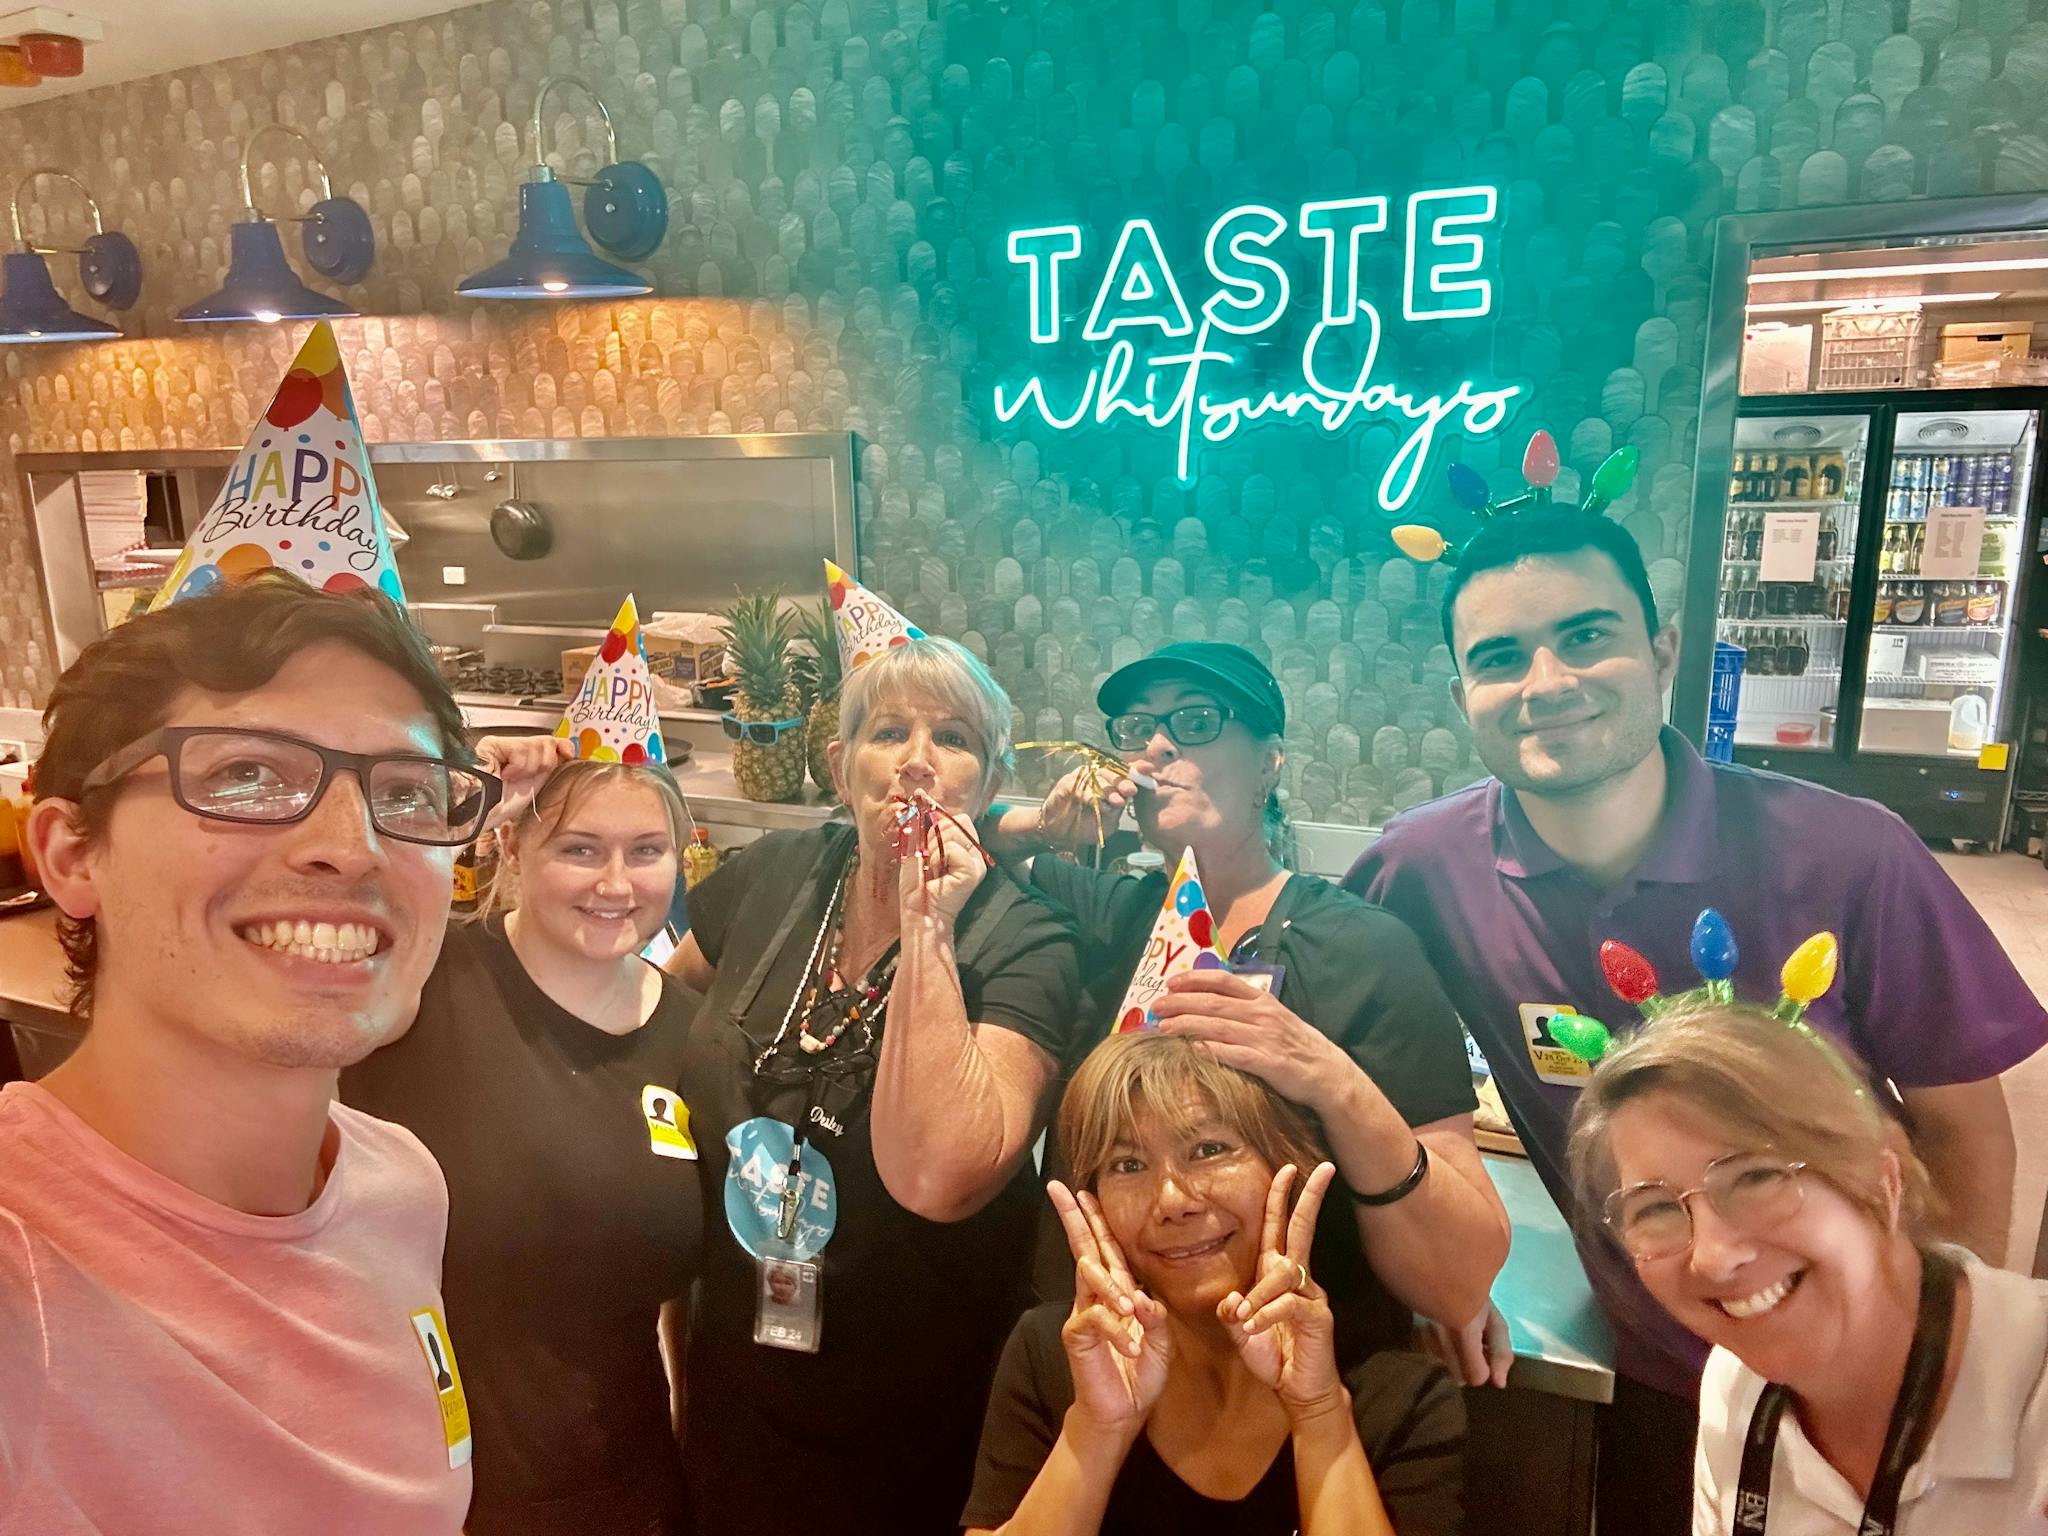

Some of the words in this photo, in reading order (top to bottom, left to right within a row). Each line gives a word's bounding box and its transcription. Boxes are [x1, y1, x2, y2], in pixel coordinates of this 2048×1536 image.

[1008, 186, 1497, 343] TASTE
[202, 495, 379, 571] Birthday
[582, 676, 652, 717] HAPPY
